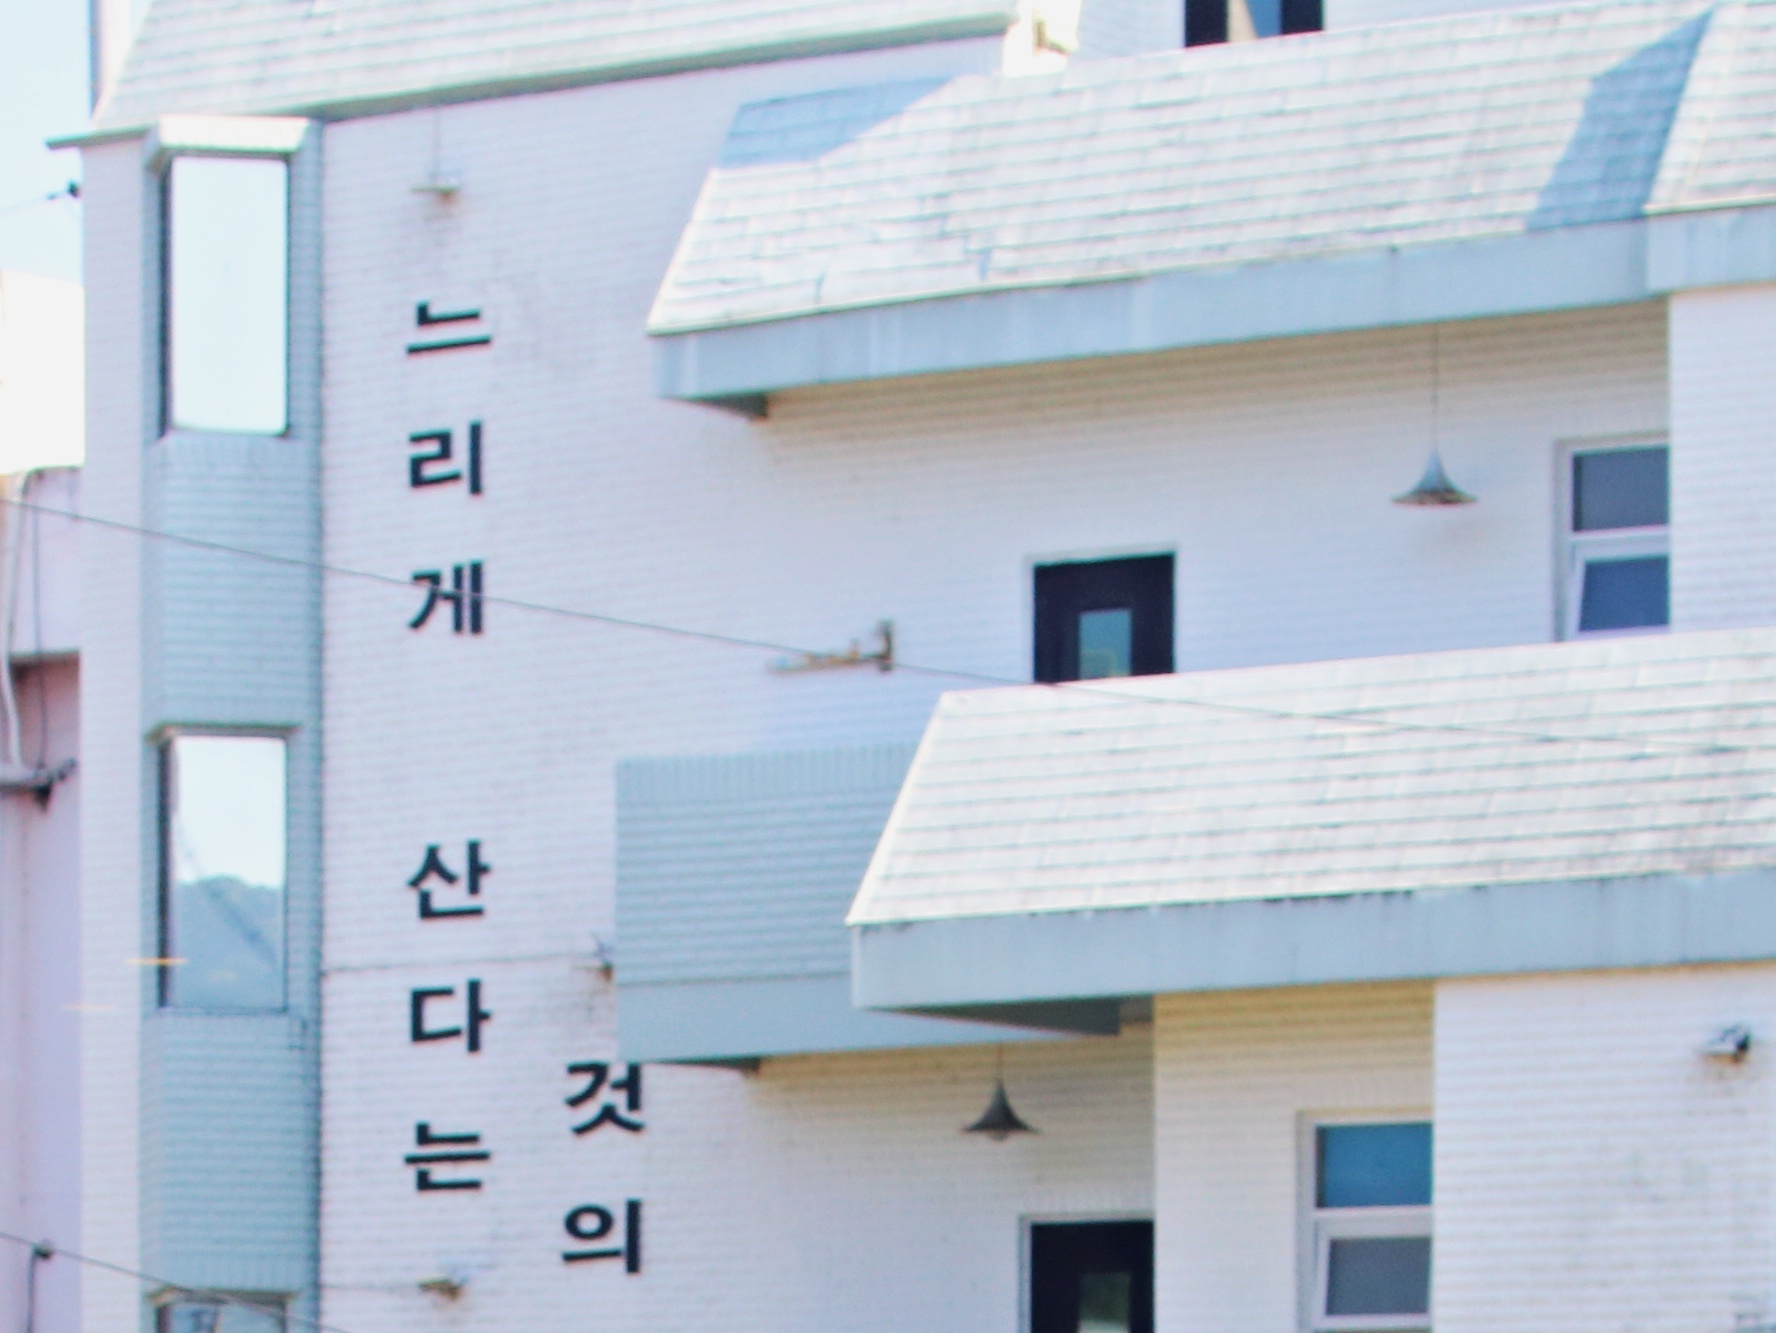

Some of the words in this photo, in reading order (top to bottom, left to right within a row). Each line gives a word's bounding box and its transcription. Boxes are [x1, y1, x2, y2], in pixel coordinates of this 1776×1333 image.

[405, 301, 491, 635] 느리게
[404, 839, 492, 1193] 산다는
[562, 1061, 645, 1274] 것의
